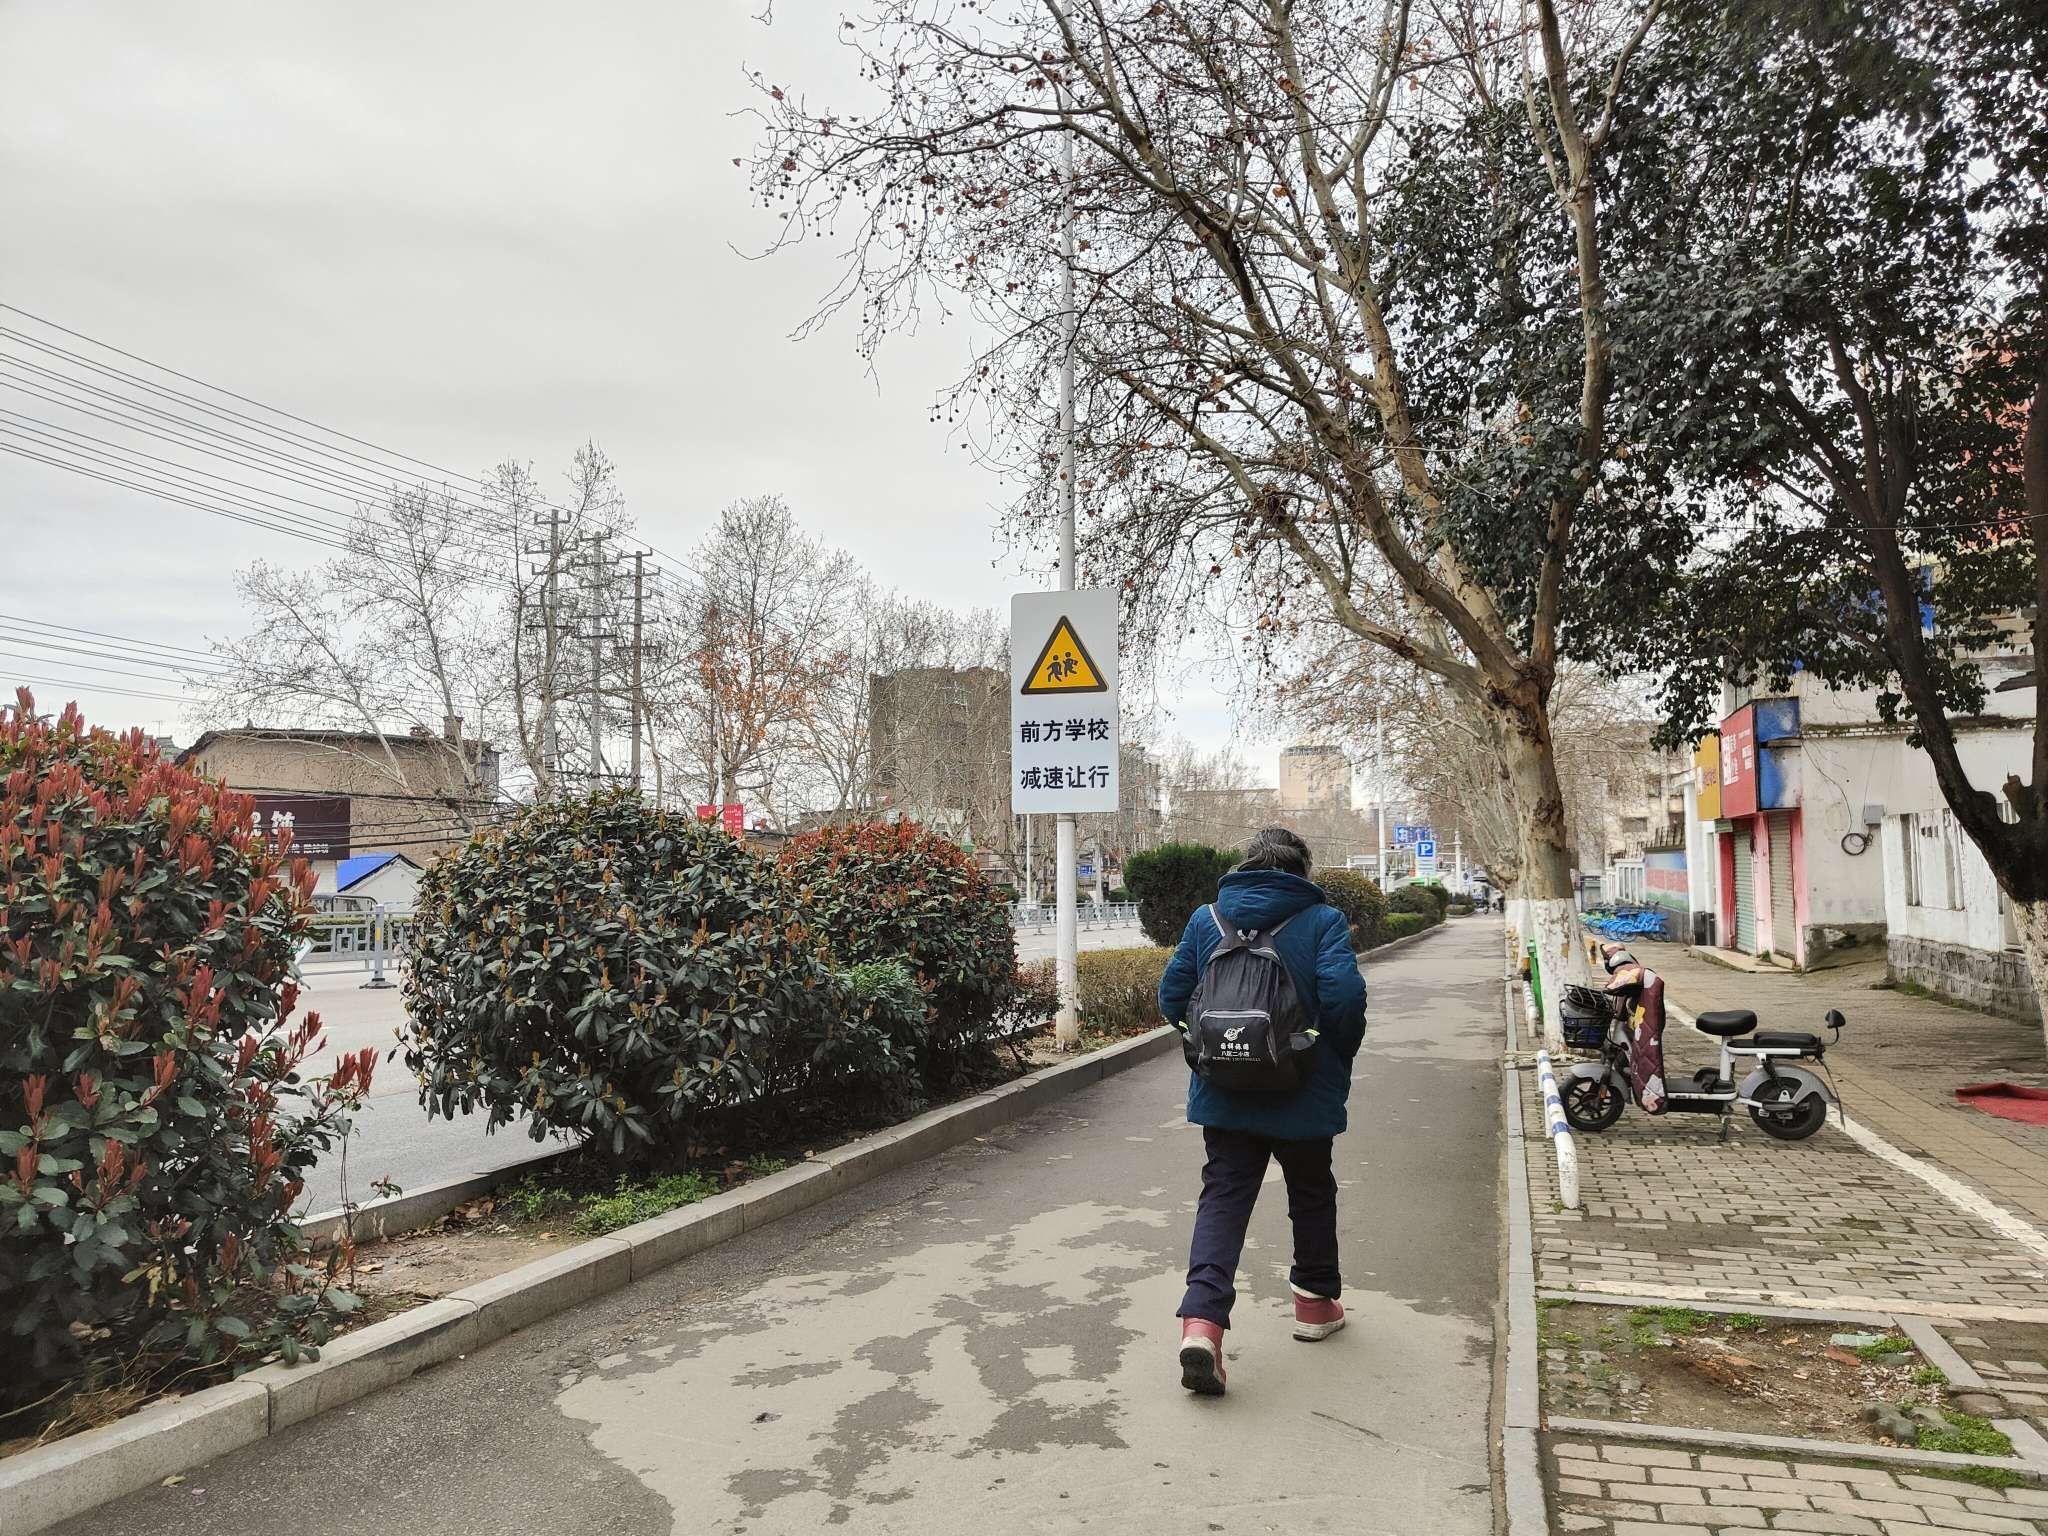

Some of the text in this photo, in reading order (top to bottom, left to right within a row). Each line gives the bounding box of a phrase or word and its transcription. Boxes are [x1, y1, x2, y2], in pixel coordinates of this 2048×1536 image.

[1020, 718, 1109, 743] 前方学校
[1020, 765, 1110, 789] 减速让行
[1420, 843, 1432, 856] P
